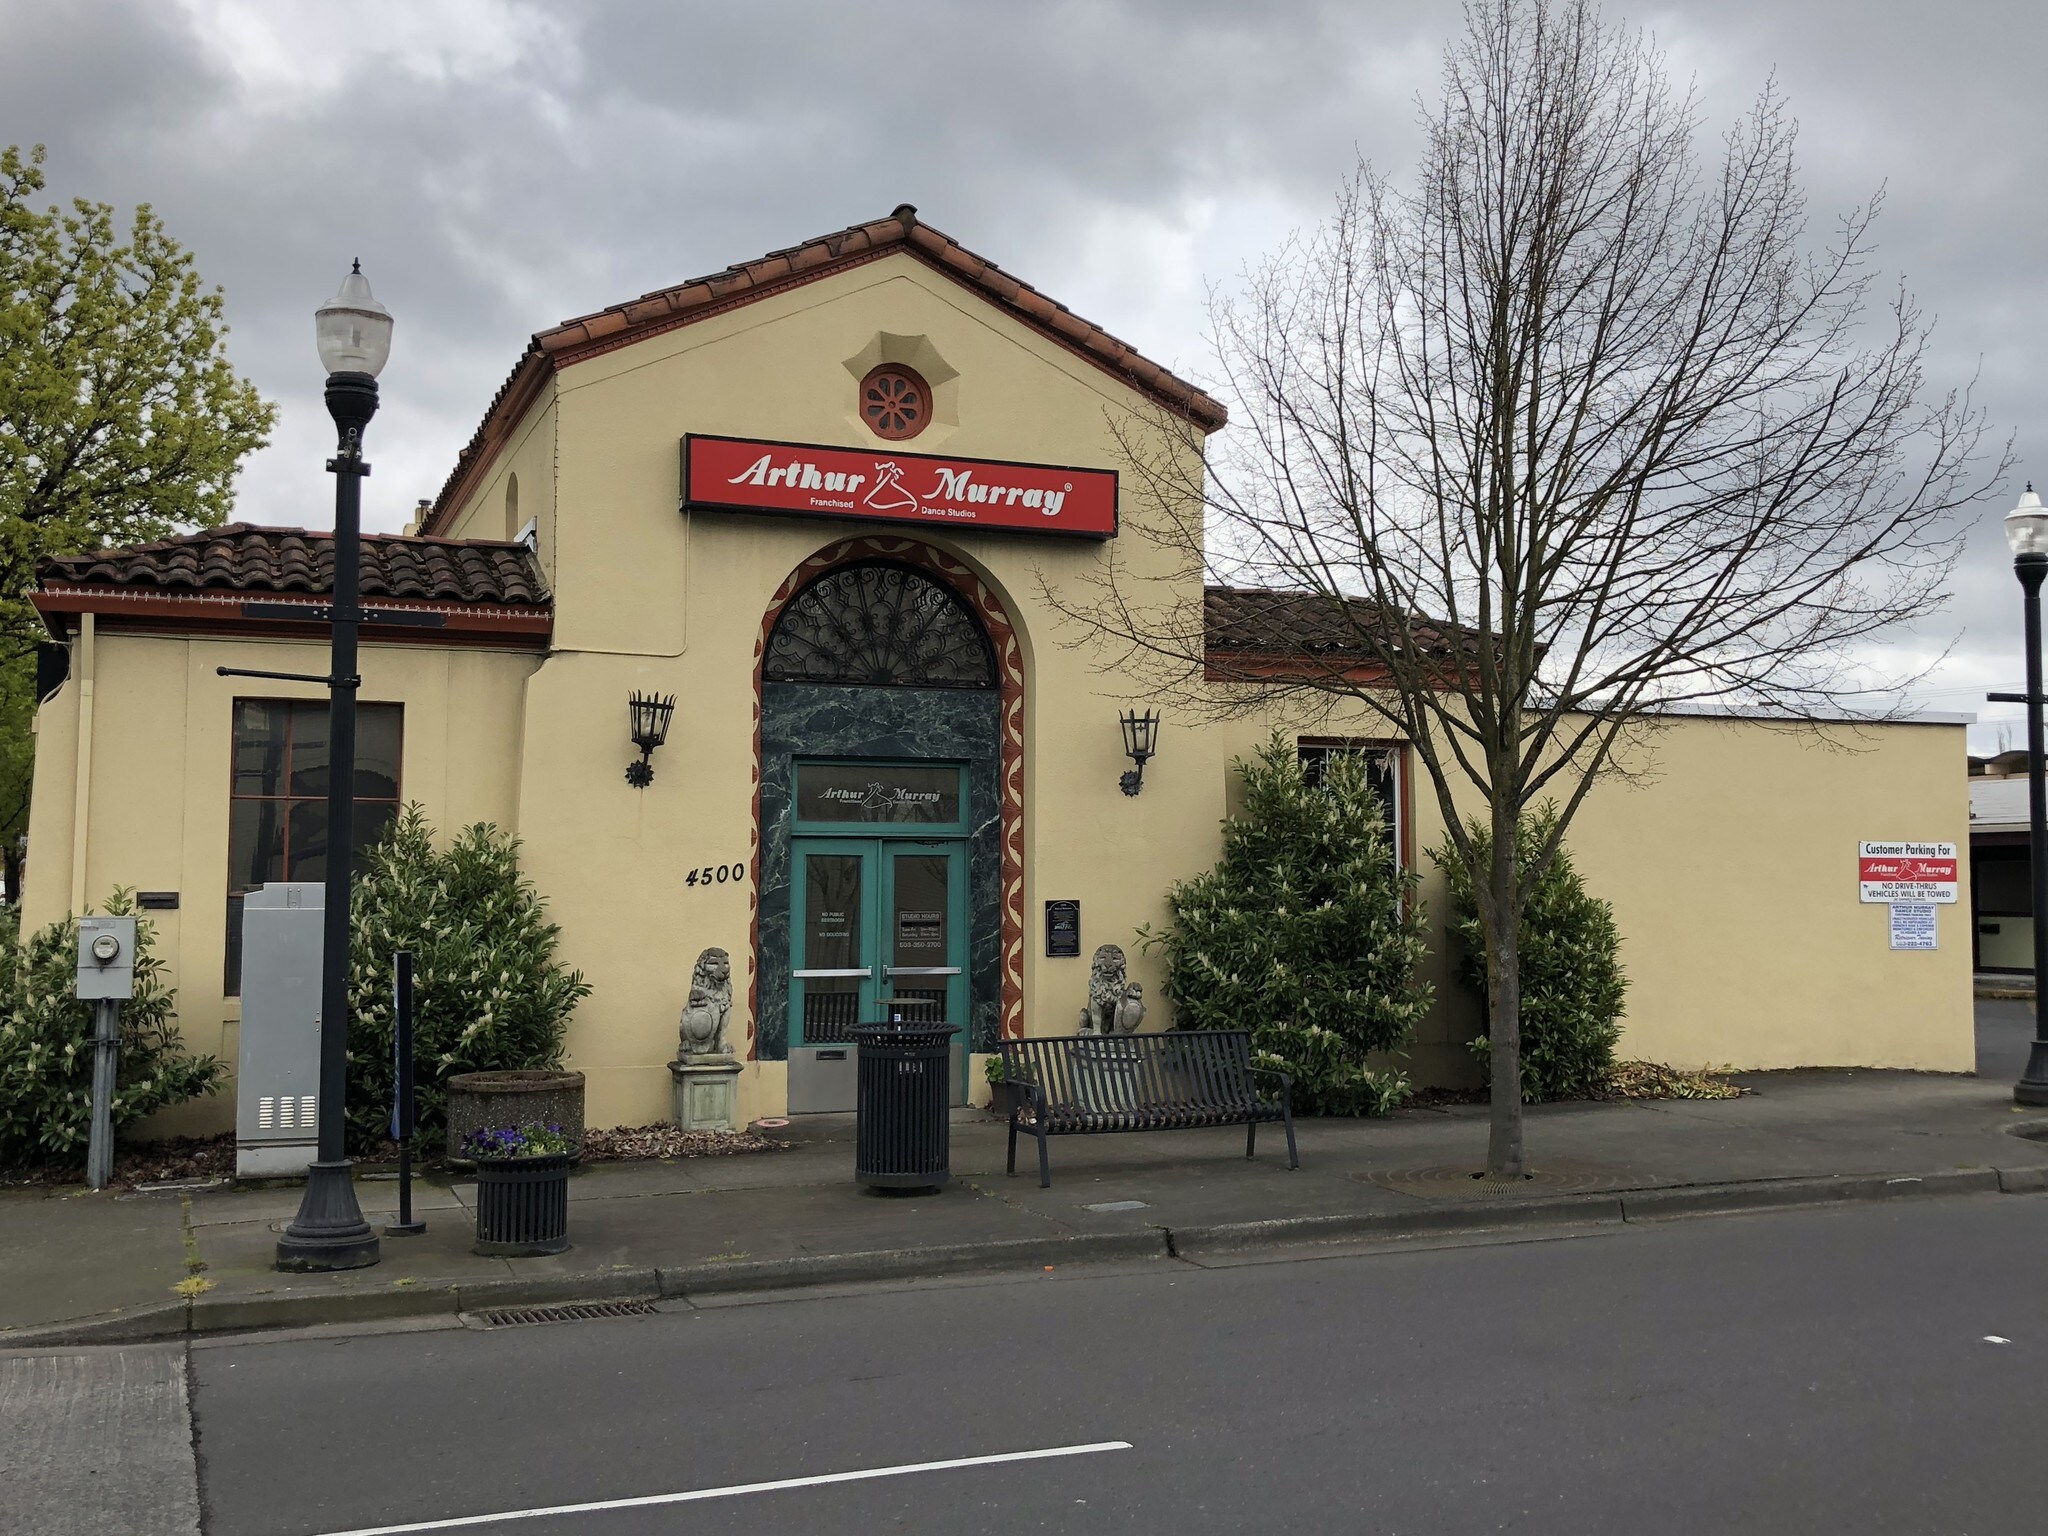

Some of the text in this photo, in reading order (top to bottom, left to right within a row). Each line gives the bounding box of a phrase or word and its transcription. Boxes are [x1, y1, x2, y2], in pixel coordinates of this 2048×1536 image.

[728, 454, 866, 493] Arthur
[810, 497, 854, 509] Franchised
[921, 506, 976, 518] Dance Studios
[818, 787, 940, 802] Arthur Murray
[1865, 843, 1950, 858] Customer Parking For
[1864, 863, 1898, 873] Arthur
[685, 863, 744, 887] 4500
[1868, 890, 1899, 898] VEHICLES
